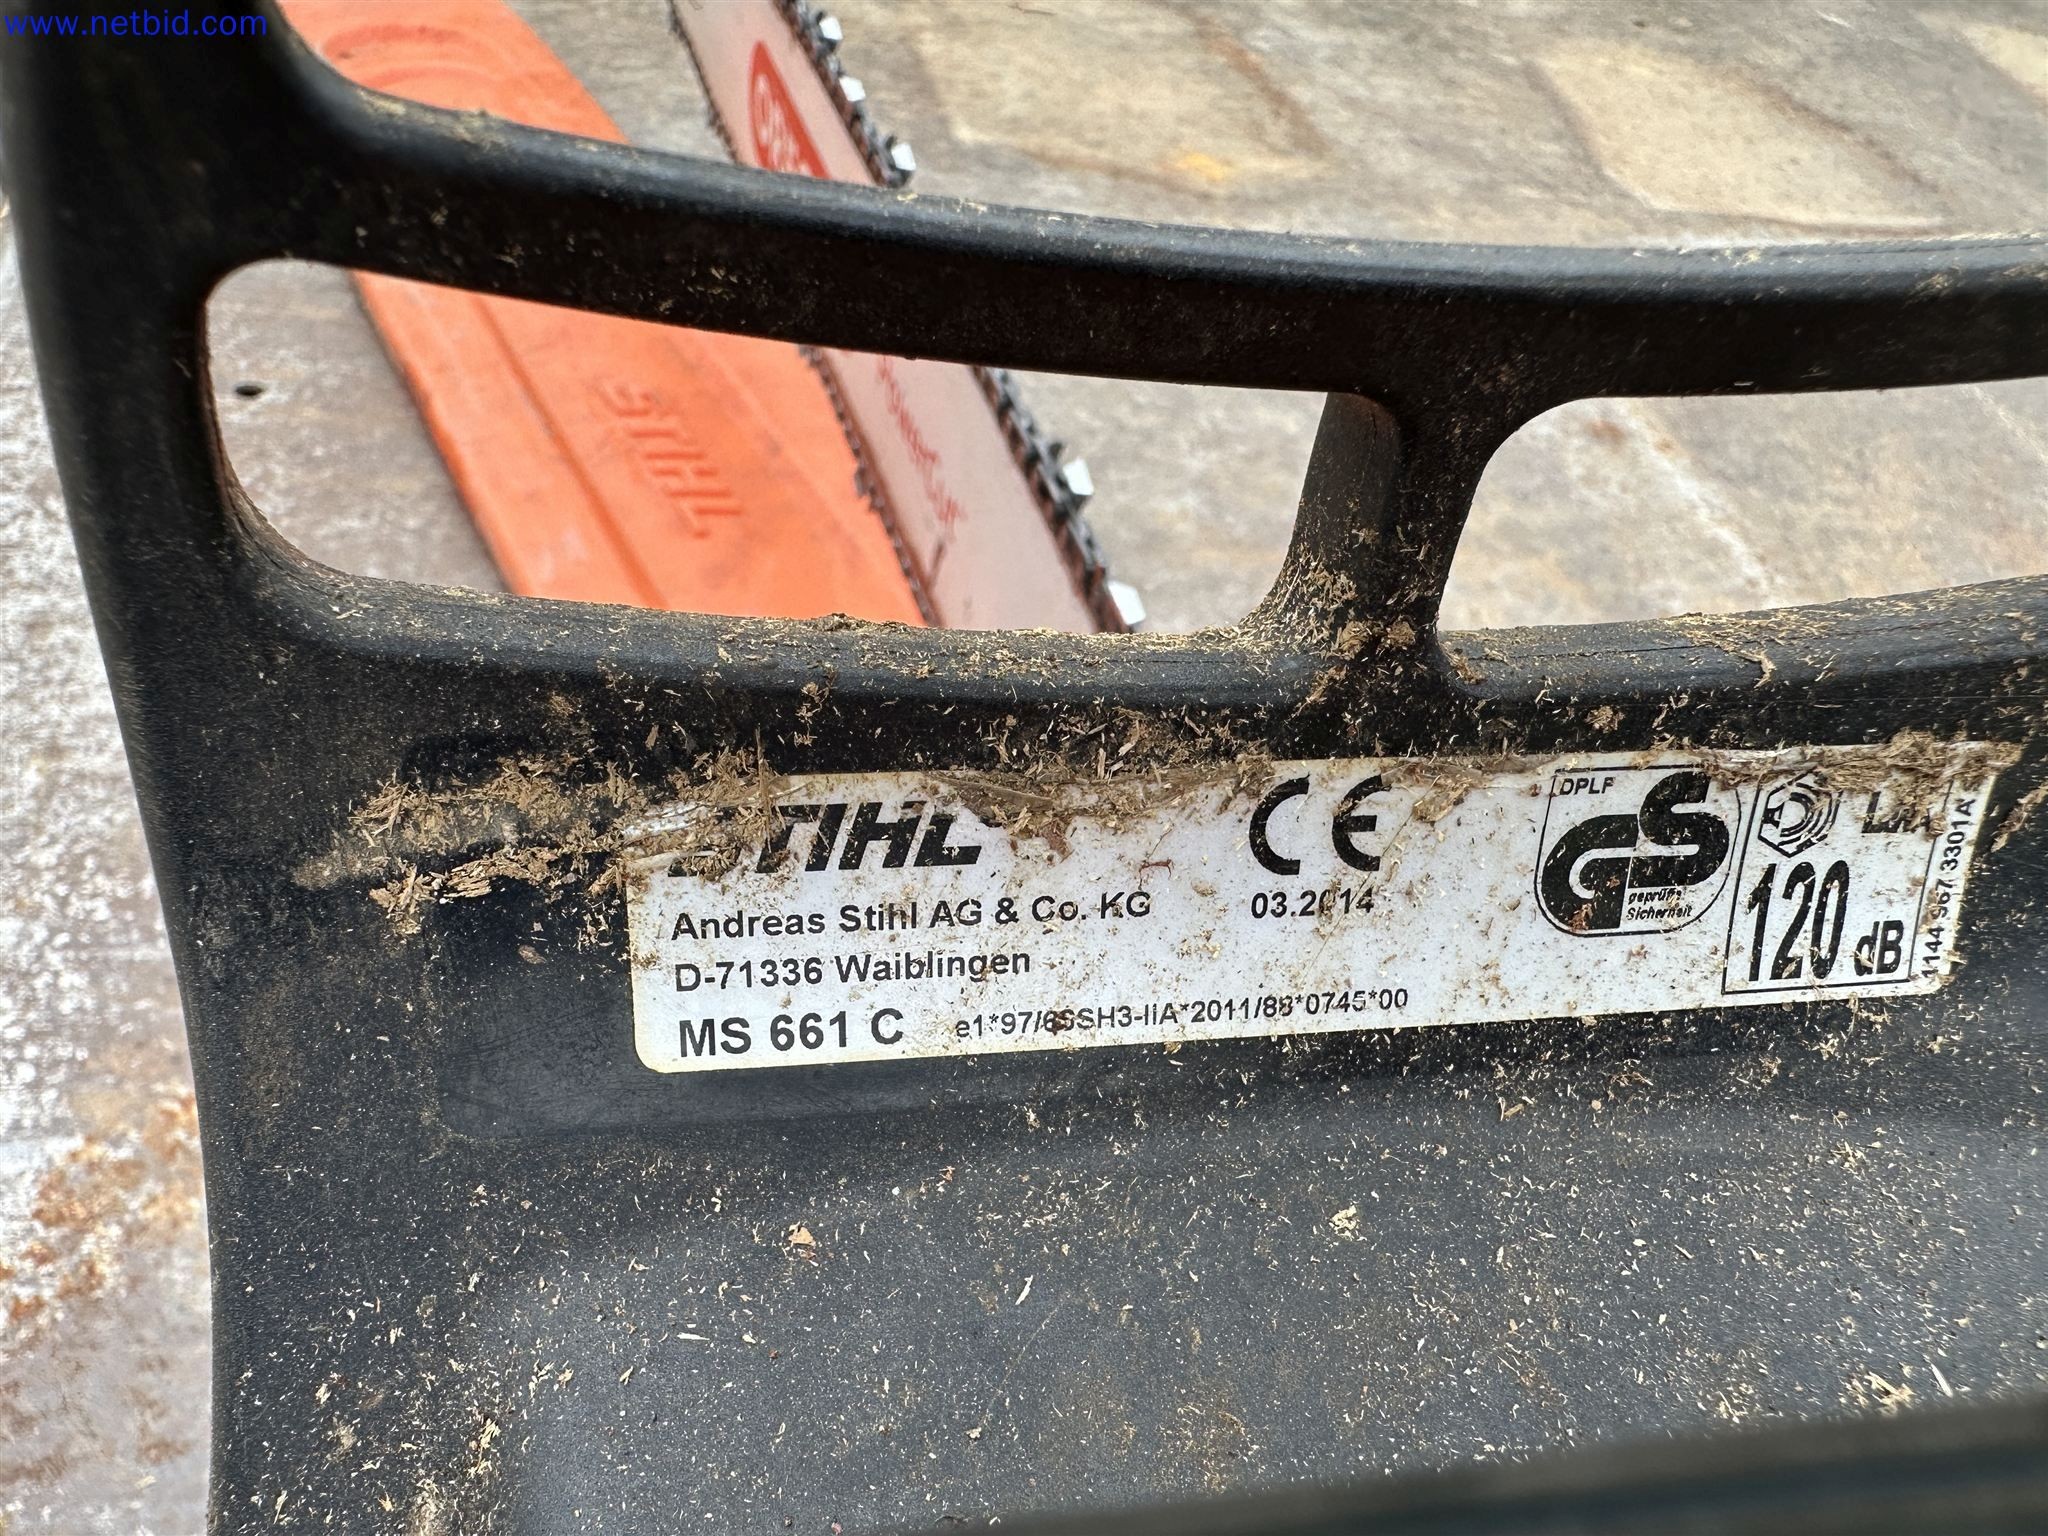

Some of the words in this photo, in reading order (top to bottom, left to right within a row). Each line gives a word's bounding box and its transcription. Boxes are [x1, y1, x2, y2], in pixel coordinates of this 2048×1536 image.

[1560, 777, 1616, 796] DPLF
[667, 800, 982, 877] TIHL
[1249, 773, 1383, 876] CE
[671, 910, 826, 941] Andreas
[838, 901, 918, 933] Stihl
[929, 899, 983, 929] AG
[994, 897, 1019, 925] &
[1031, 896, 1087, 923] Co.
[1100, 891, 1152, 920] KG
[1921, 926, 1945, 979] 1144
[1940, 797, 1976, 872] 3301A
[1747, 860, 1850, 982] 120
[1853, 920, 1904, 977] dB
[675, 956, 823, 992] D-71336
[834, 950, 1031, 983] Waiblingen
[679, 1017, 752, 1058] MS
[769, 1011, 848, 1052] 661
[870, 1008, 904, 1045] C
